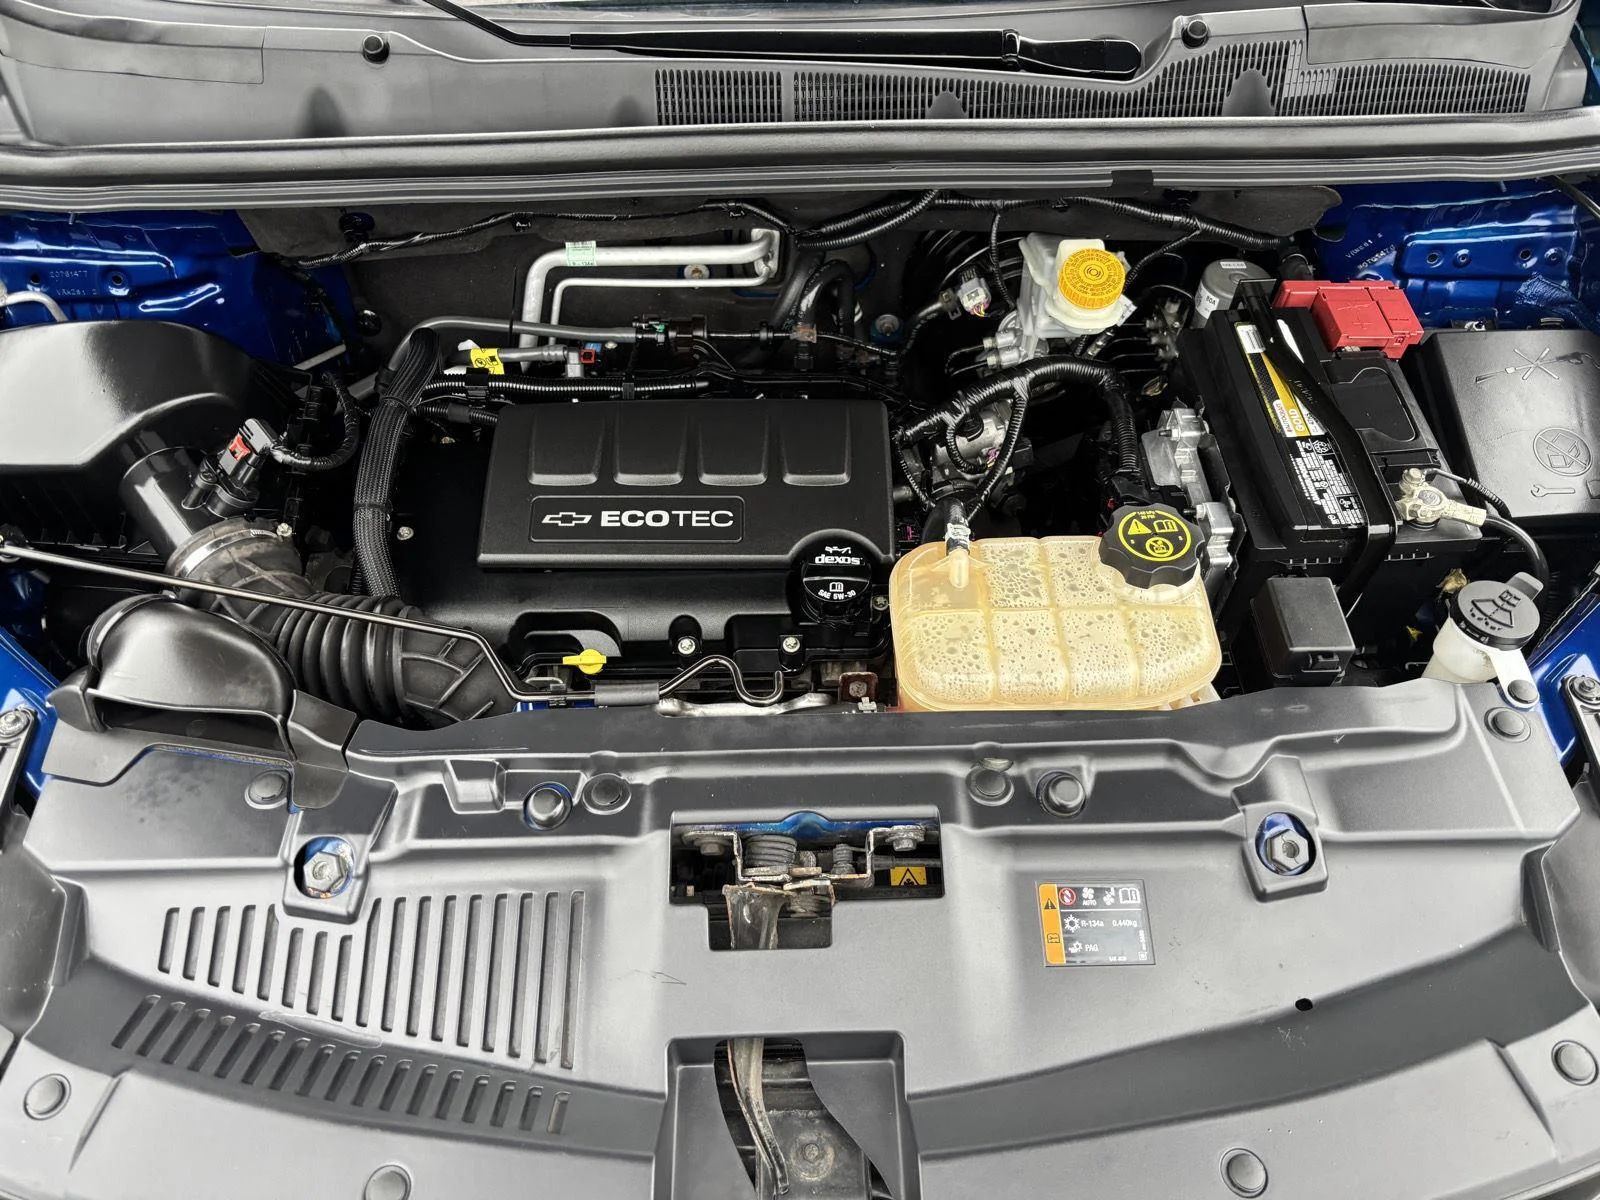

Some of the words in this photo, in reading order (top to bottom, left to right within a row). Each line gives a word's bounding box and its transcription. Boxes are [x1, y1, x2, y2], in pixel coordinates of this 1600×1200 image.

[1288, 409, 1305, 432] GOLD
[600, 510, 734, 528] ECOTEC
[815, 554, 861, 565] dexos
[818, 589, 832, 599] SAE
[833, 590, 856, 600] 5W-30
[1085, 944, 1098, 952] PAG
